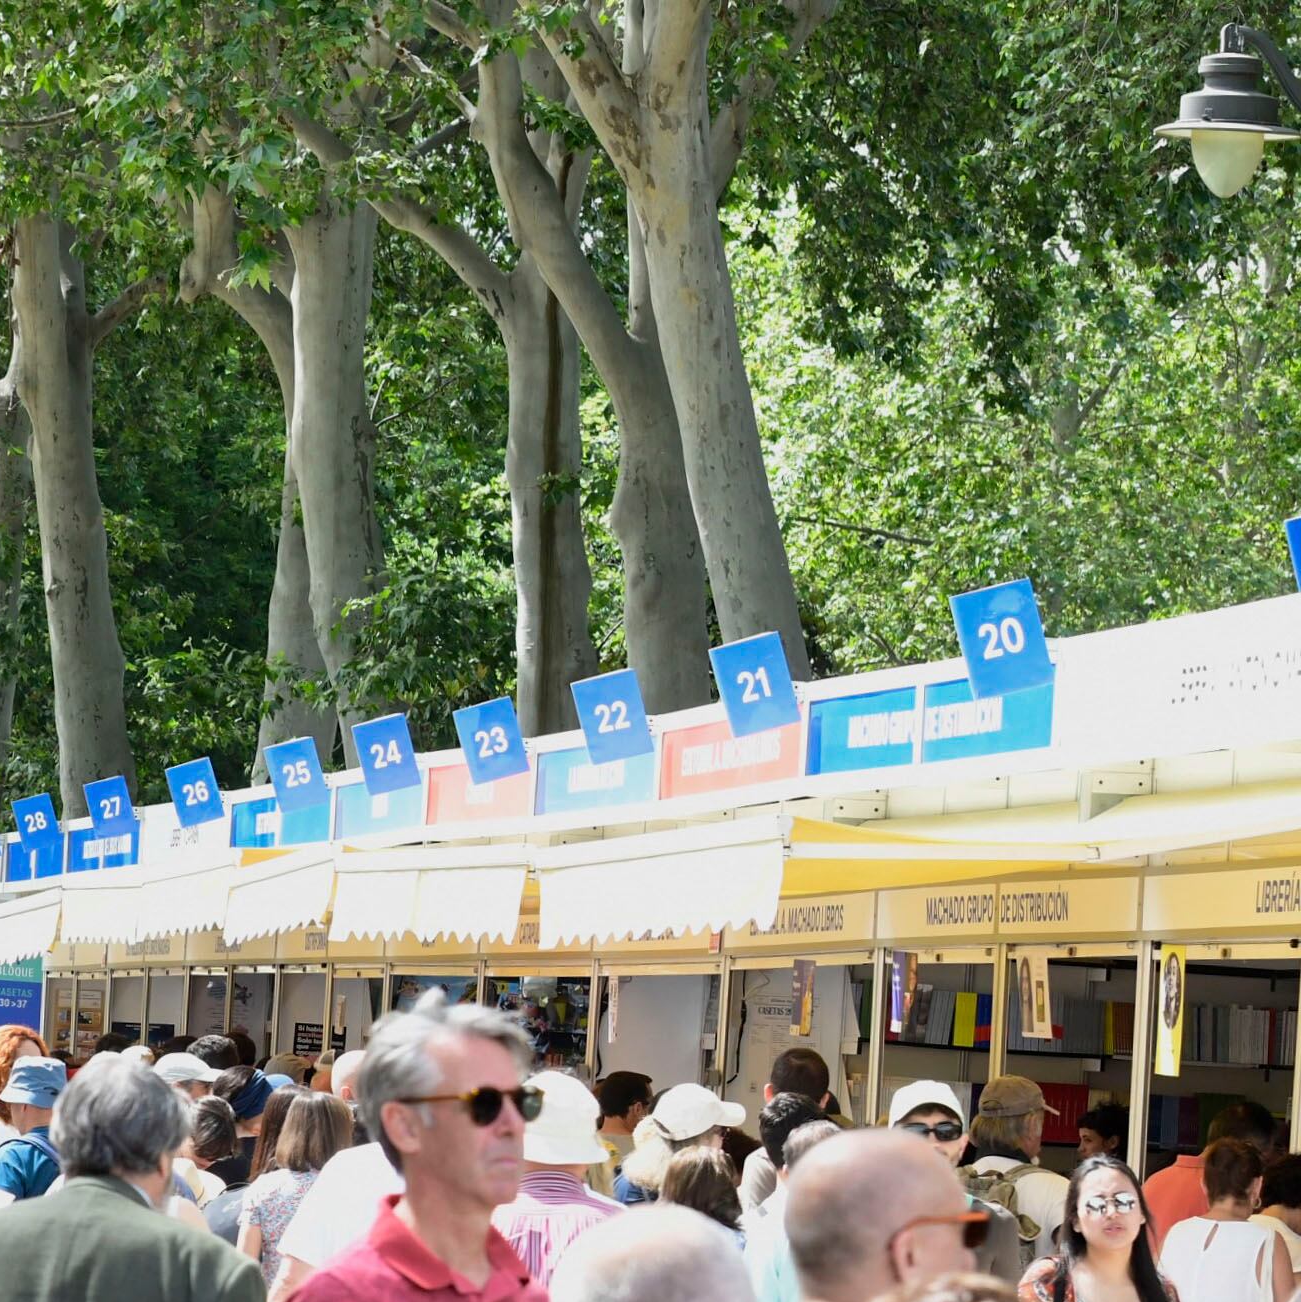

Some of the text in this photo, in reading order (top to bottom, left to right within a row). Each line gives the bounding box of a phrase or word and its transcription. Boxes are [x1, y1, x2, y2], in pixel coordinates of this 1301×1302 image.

[978, 616, 1025, 660] 20
[737, 667, 773, 704] 21
[594, 700, 632, 734] 22
[370, 739, 402, 769] 24
[474, 726, 509, 758] 23
[282, 760, 312, 788] 25
[99, 795, 121, 820] 27
[182, 780, 209, 806] 26
[24, 811, 48, 834] 28
[788, 905, 821, 934] MACHADO
[821, 903, 844, 932] LIBROS
[926, 883, 1069, 925] MACHADO GRUPO DE DISTRIBUCIÓN
